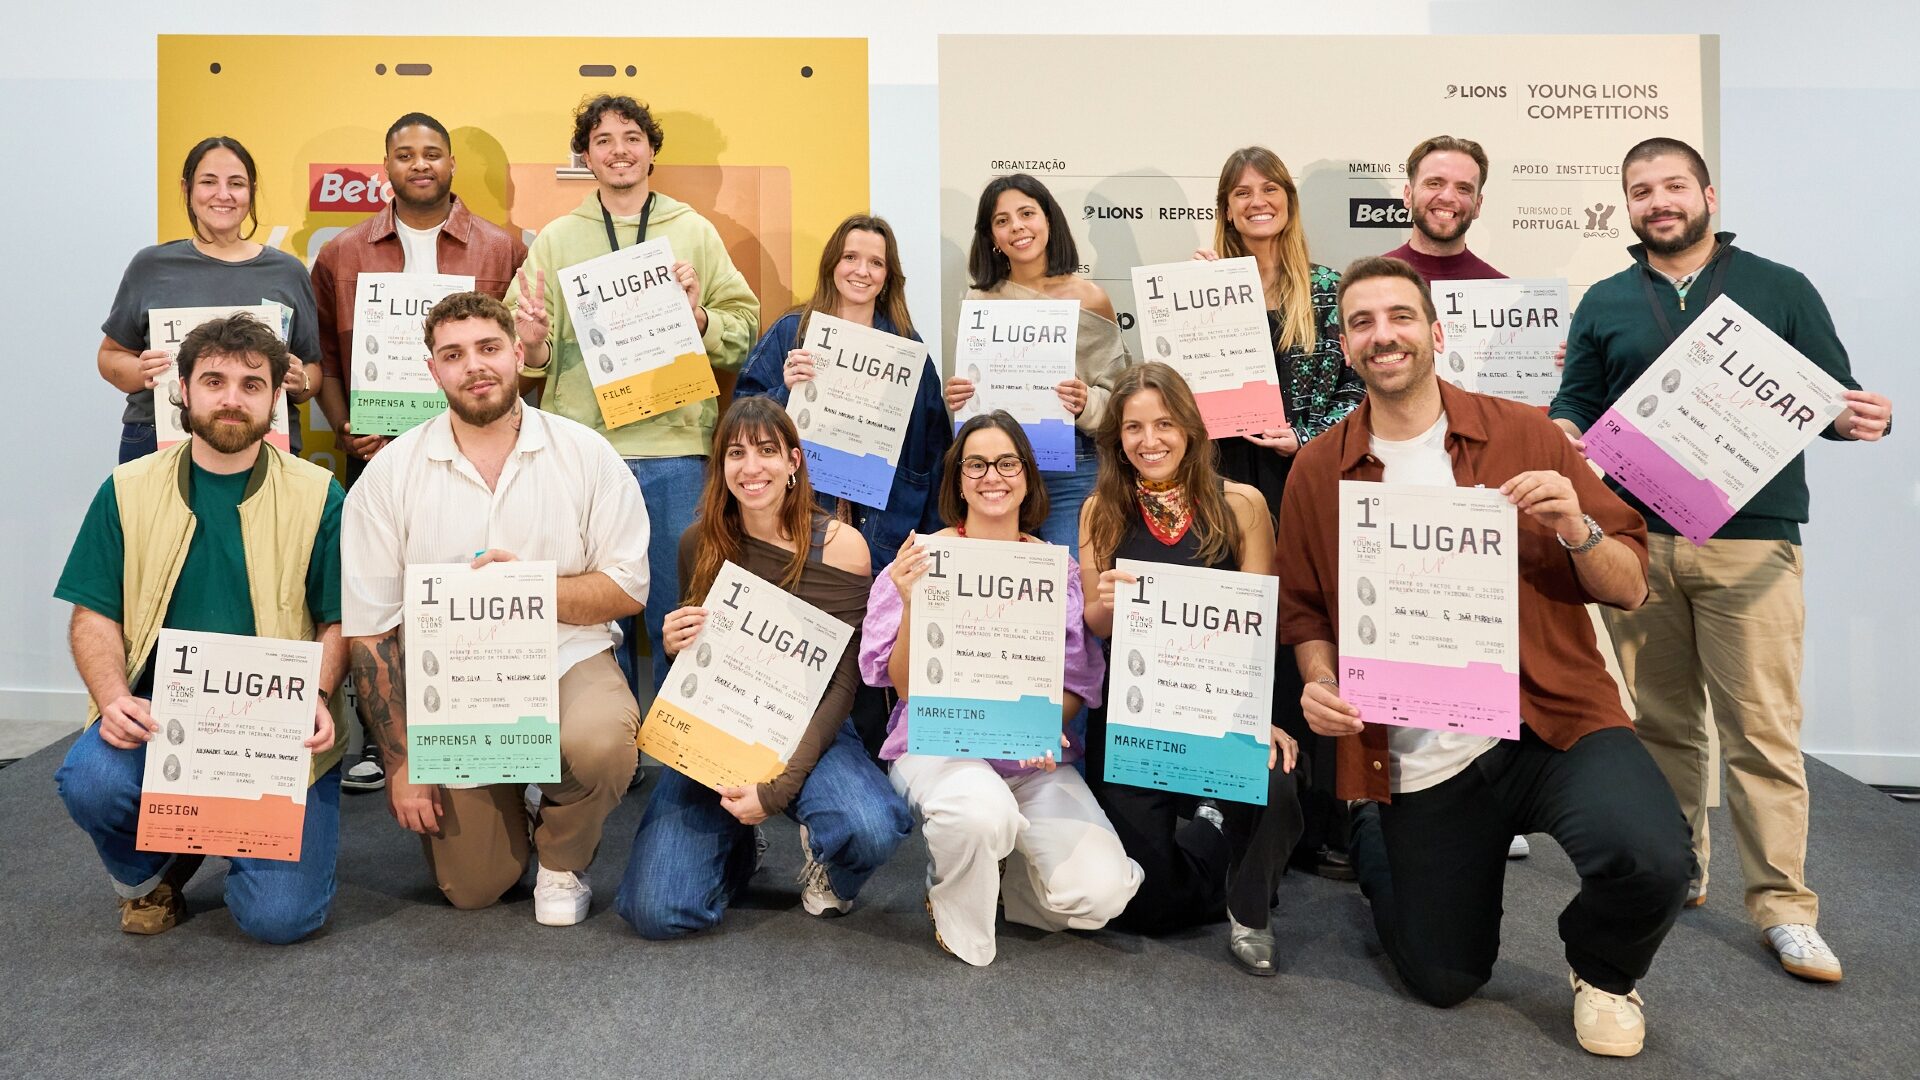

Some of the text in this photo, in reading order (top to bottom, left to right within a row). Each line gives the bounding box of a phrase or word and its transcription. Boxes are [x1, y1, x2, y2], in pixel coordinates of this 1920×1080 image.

[1460, 86, 1507, 98] LIONS
[1528, 84, 1658, 99] YOUNG LIONS
[1528, 105, 1669, 120] COMPETITIONS
[991, 158, 1066, 172] ORGANIZAÇÃO
[1349, 163, 1391, 173] NAMING
[1512, 165, 1620, 174] APOIO INSTITUCI
[1098, 207, 1217, 220] LIONS REPRES
[1518, 206, 1572, 215] TURISMO DE
[1512, 219, 1580, 230] PORTUGAL
[598, 264, 671, 302] LUGAR
[1173, 284, 1254, 310] LUGAR
[1473, 308, 1558, 327] LUGAR
[992, 325, 1066, 342] LUGAR
[836, 348, 912, 386] LUGAR
[603, 386, 632, 400] FILME
[1718, 350, 1817, 431] LUGAR
[358, 398, 404, 408] IMPRENSA
[1604, 420, 1620, 435] PR
[1390, 522, 1501, 555] LUGAR
[958, 573, 1054, 602] LUGAR
[450, 596, 544, 620] LUGAR
[1161, 600, 1262, 636] LUGAR
[740, 610, 829, 672] LUGAR
[1348, 668, 1365, 681] PR
[203, 669, 305, 700] LUGAR
[917, 706, 985, 720] MARKETING
[656, 709, 692, 734] FILME
[417, 734, 552, 746] IMPRENSA & OUTDOOR
[1114, 734, 1187, 755] MARKETING
[149, 803, 199, 816] DESIGN
